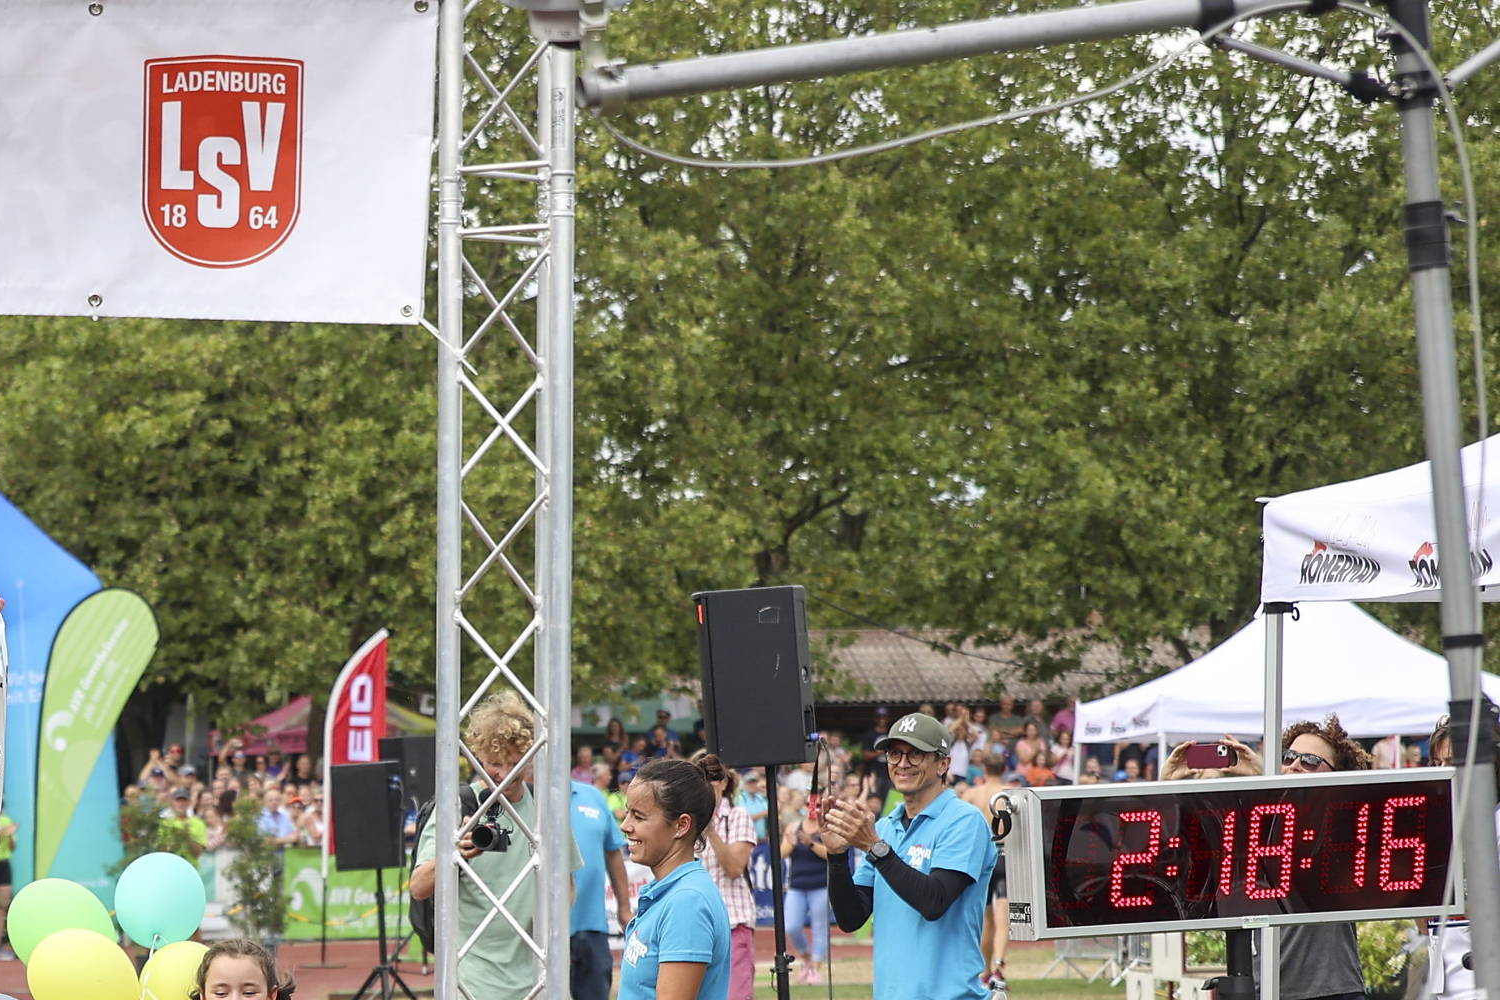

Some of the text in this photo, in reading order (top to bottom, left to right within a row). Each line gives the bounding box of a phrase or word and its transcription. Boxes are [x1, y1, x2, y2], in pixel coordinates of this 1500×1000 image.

[162, 72, 287, 95] LADENBURG
[159, 203, 279, 230] 18 64
[1111, 796, 1428, 908] 2:18:16
